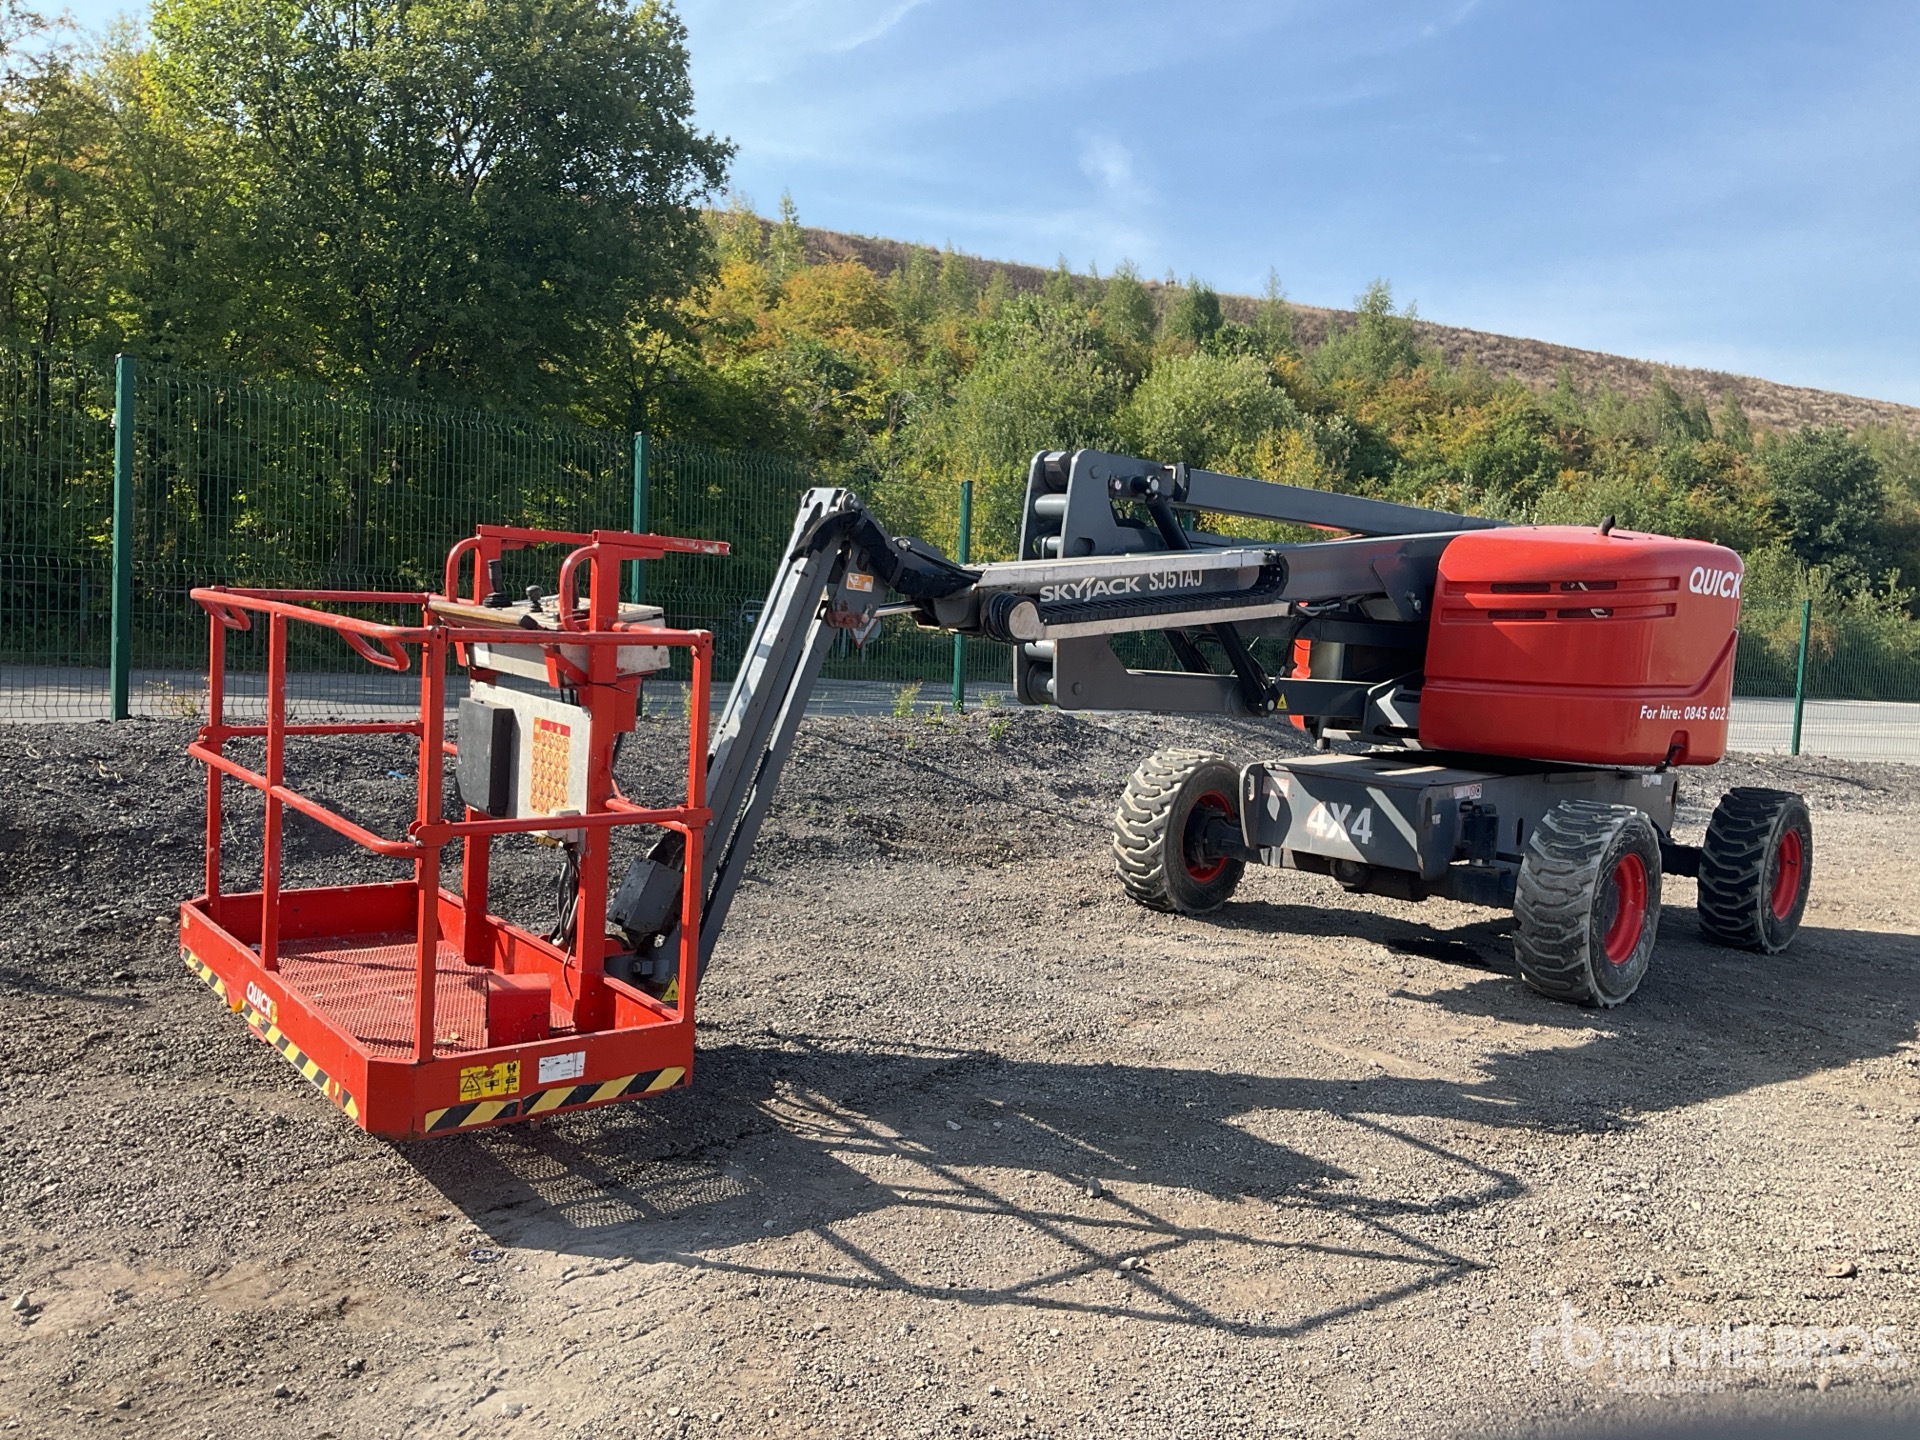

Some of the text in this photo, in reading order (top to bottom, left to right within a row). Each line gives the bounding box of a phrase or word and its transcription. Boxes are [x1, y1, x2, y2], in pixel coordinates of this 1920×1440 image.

[1039, 568, 1203, 603] SKYJACK SJ51AJ
[1689, 566, 1743, 599] QUICK
[1640, 705, 1657, 720] For
[1660, 705, 1681, 720] hire:
[1684, 706, 1707, 720] 0845
[1709, 706, 1726, 721] 602
[1306, 801, 1373, 845] 4X4
